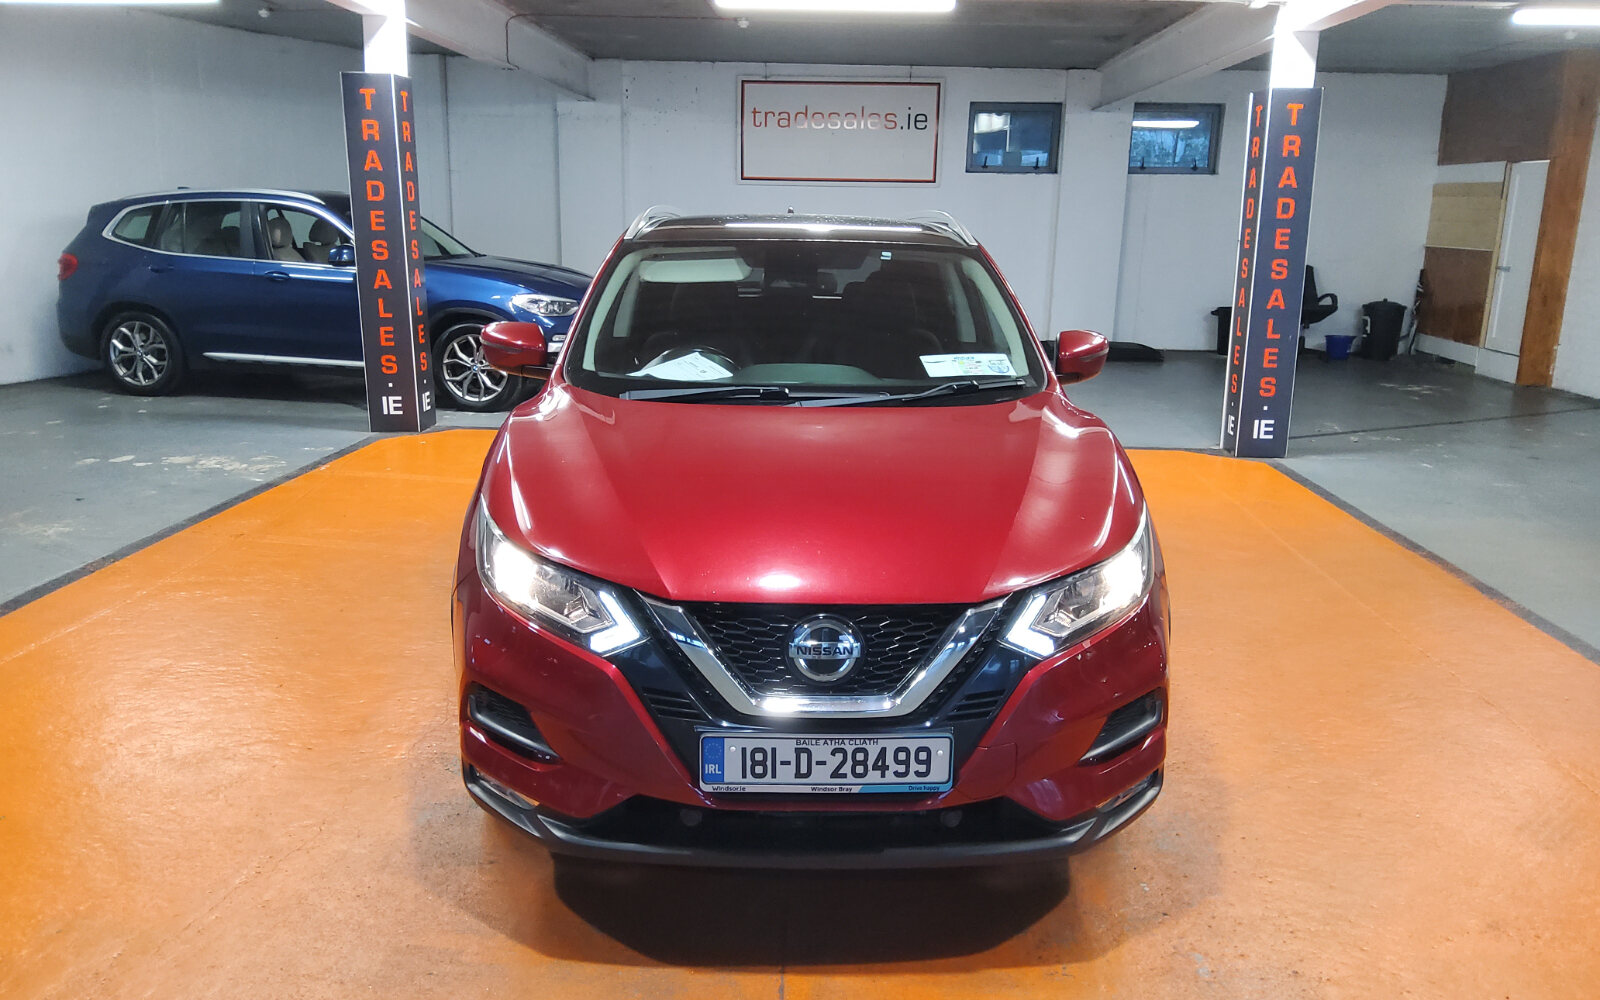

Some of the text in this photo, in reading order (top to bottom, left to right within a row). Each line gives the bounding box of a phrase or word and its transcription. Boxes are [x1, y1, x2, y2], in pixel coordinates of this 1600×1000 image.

[752, 105, 928, 130] tradesales.ie
[797, 646, 853, 656] NISSAN
[705, 764, 721, 774] IRL
[741, 747, 931, 779] 181-D-28499
